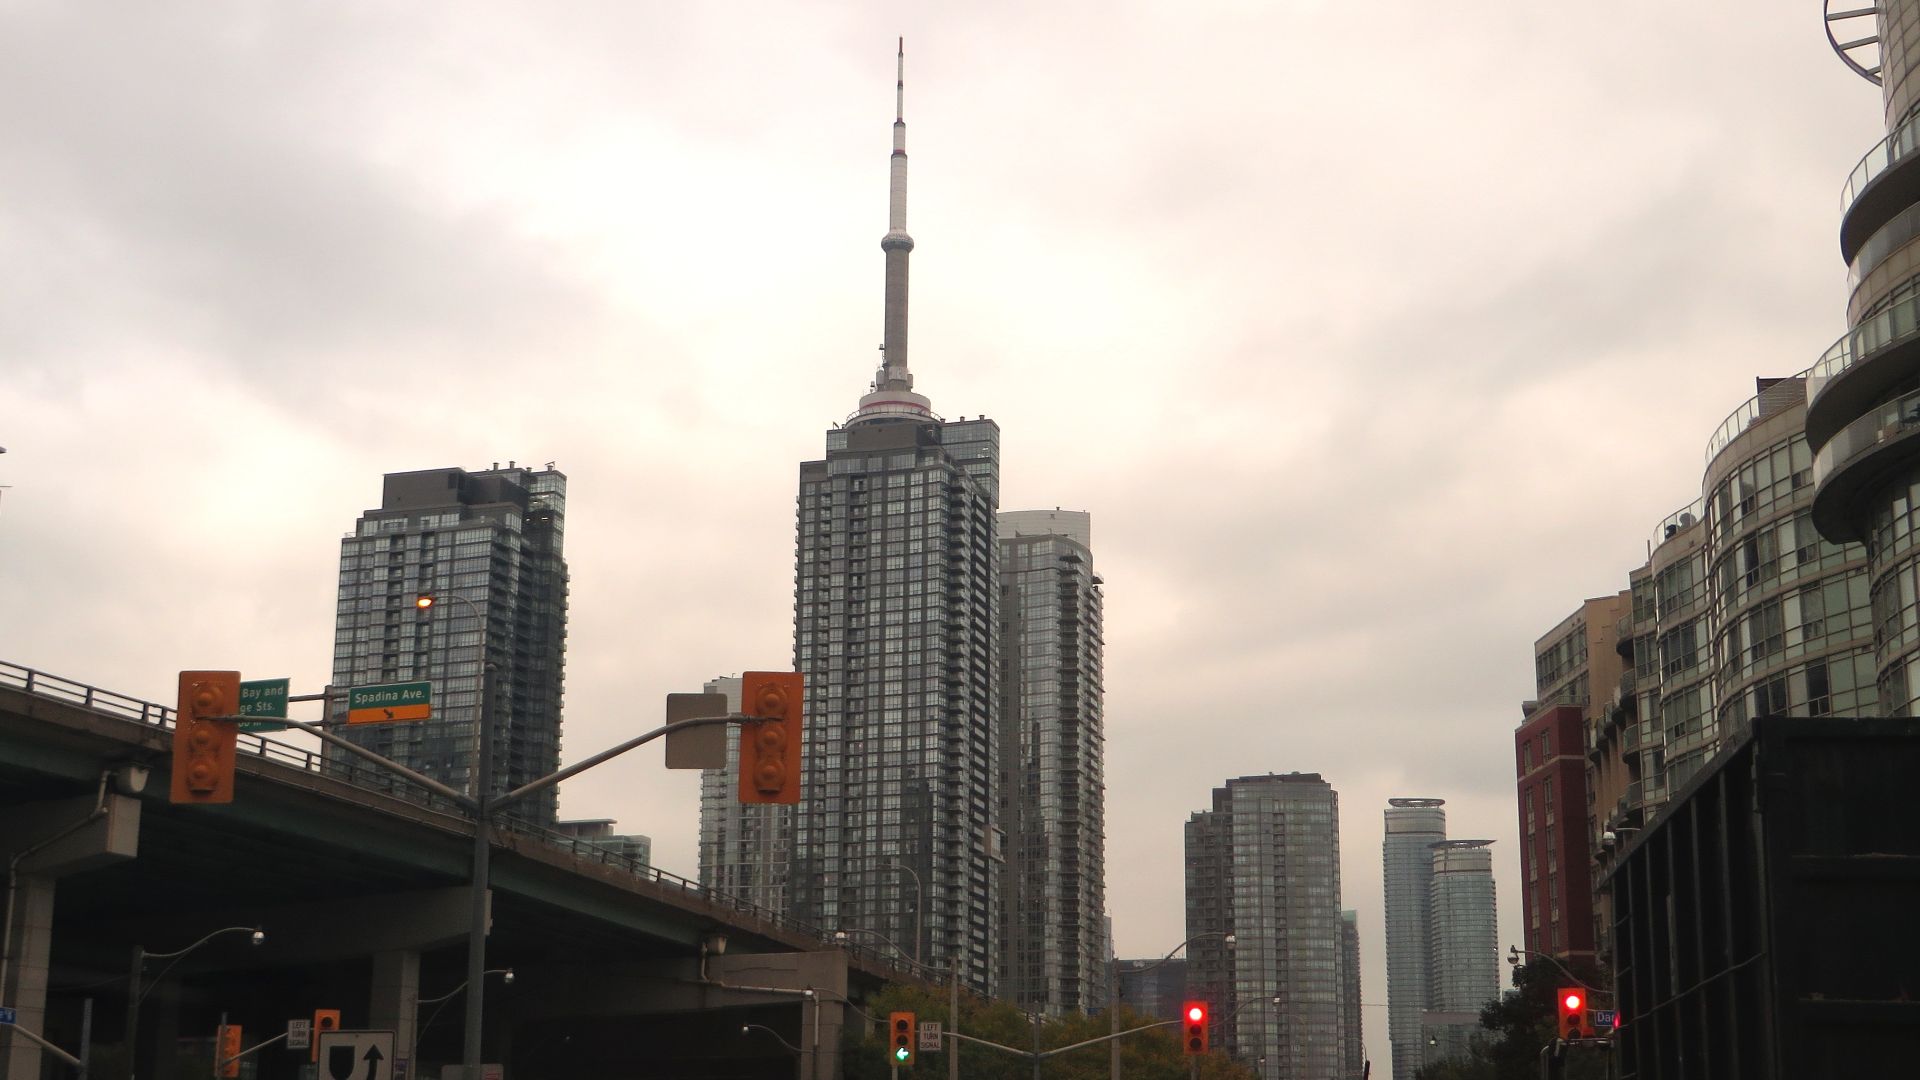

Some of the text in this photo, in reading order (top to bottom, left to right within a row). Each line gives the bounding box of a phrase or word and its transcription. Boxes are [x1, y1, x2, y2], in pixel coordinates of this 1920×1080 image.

[242, 686, 284, 699] Bay and
[354, 689, 425, 705] Spadina Ave.
[256, 701, 276, 712] Sts.
[923, 1023, 938, 1031] LEFT
[923, 1032, 939, 1040] TURN
[920, 1041, 940, 1049] SIGNAL
